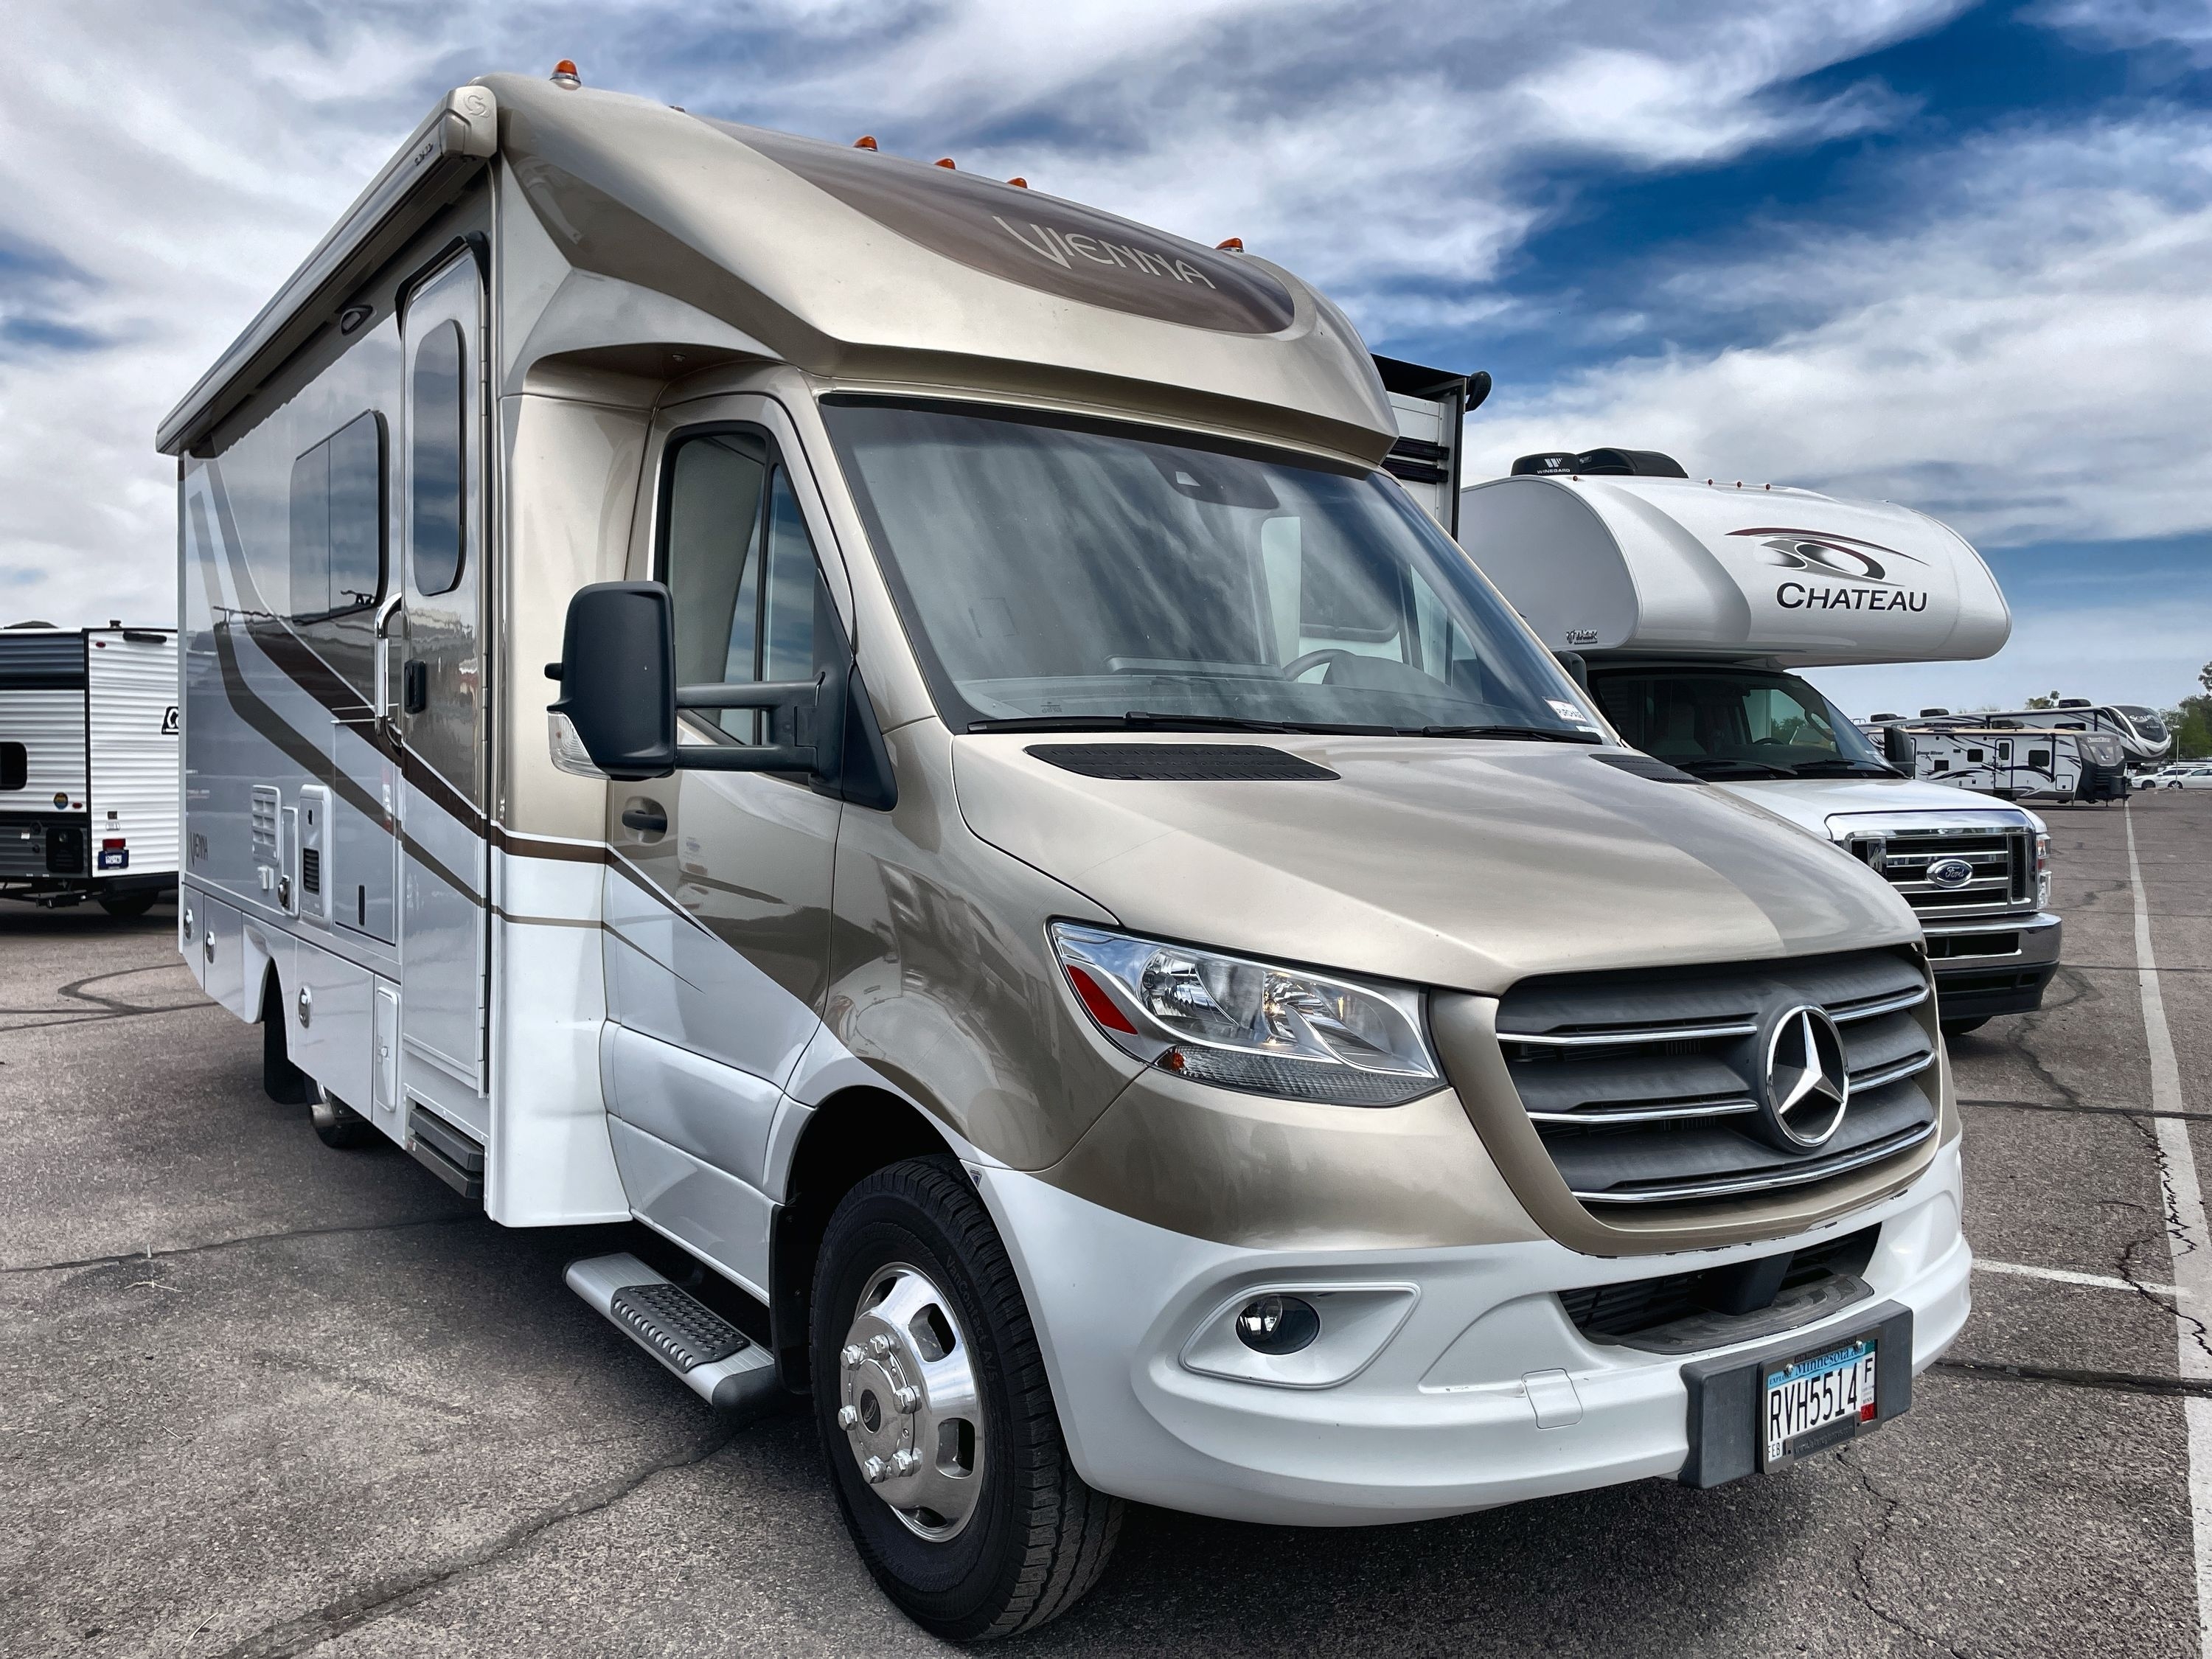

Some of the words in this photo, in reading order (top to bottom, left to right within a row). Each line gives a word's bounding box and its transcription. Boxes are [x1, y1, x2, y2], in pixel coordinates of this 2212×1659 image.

[992, 215, 1217, 290] VIENNA
[1775, 582, 1928, 613] CHATEAU
[1944, 866, 1965, 879] Ford
[1770, 1362, 1858, 1442] RVH5514
